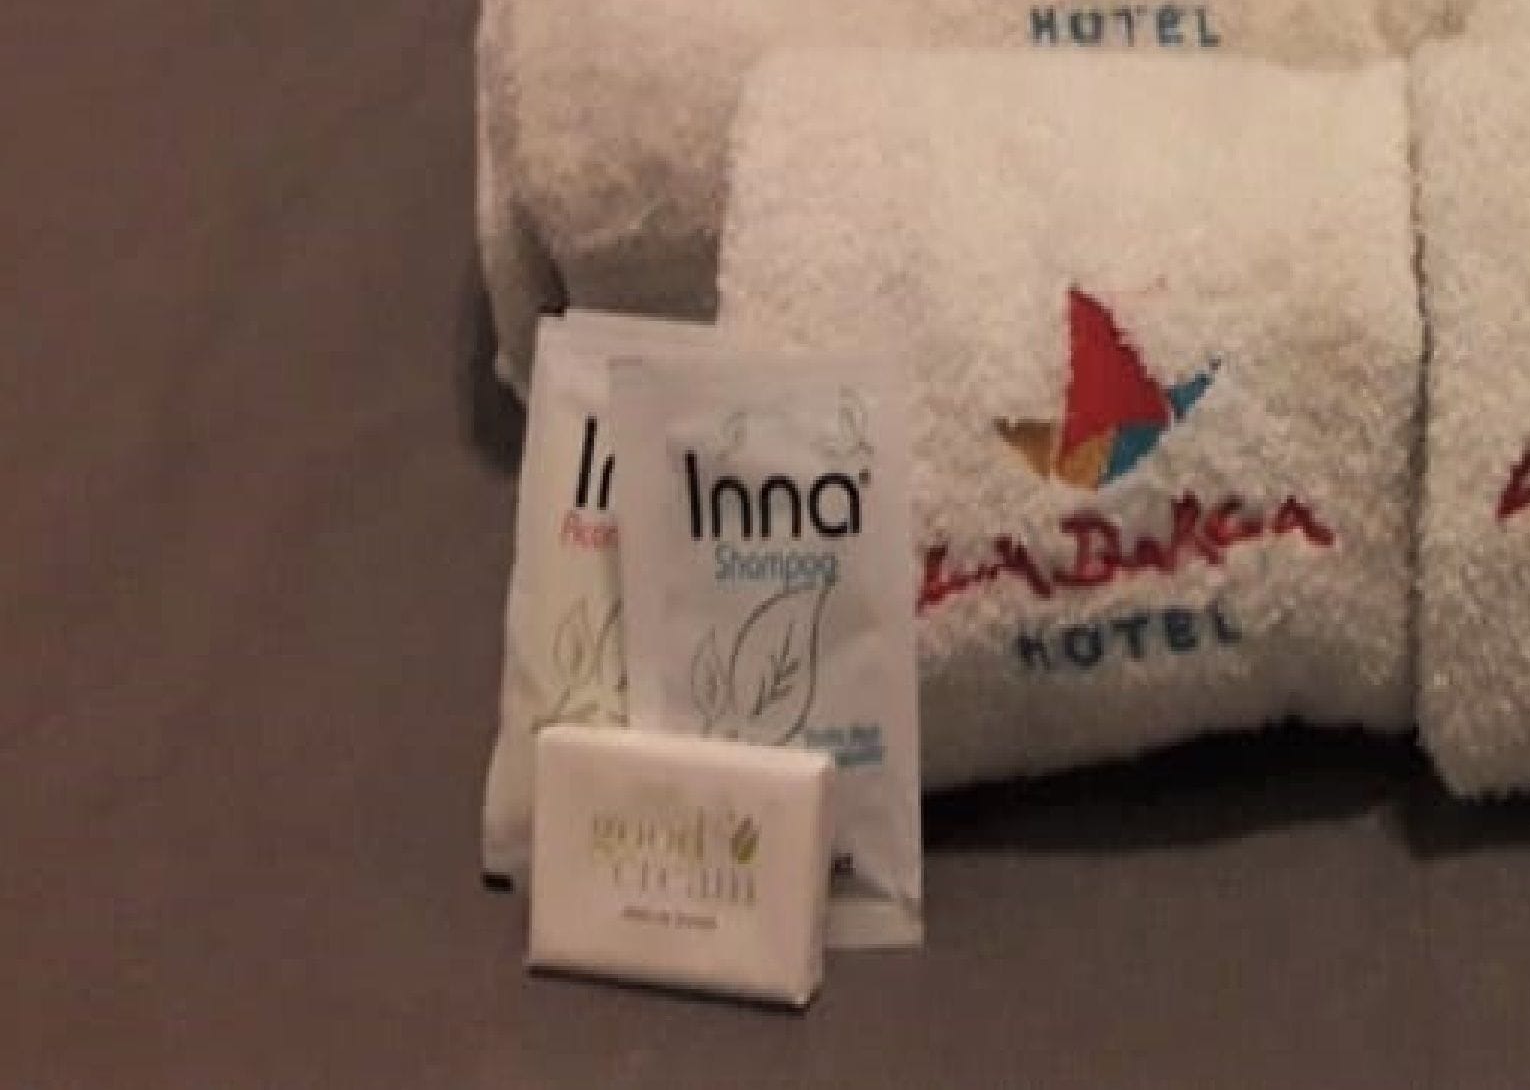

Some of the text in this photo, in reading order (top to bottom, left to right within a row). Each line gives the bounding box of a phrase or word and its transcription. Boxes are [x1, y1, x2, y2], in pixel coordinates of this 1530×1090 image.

[1028, 5, 1223, 48] HOTEL
[683, 448, 862, 542] Inna
[1012, 600, 1243, 672] HOTEL
